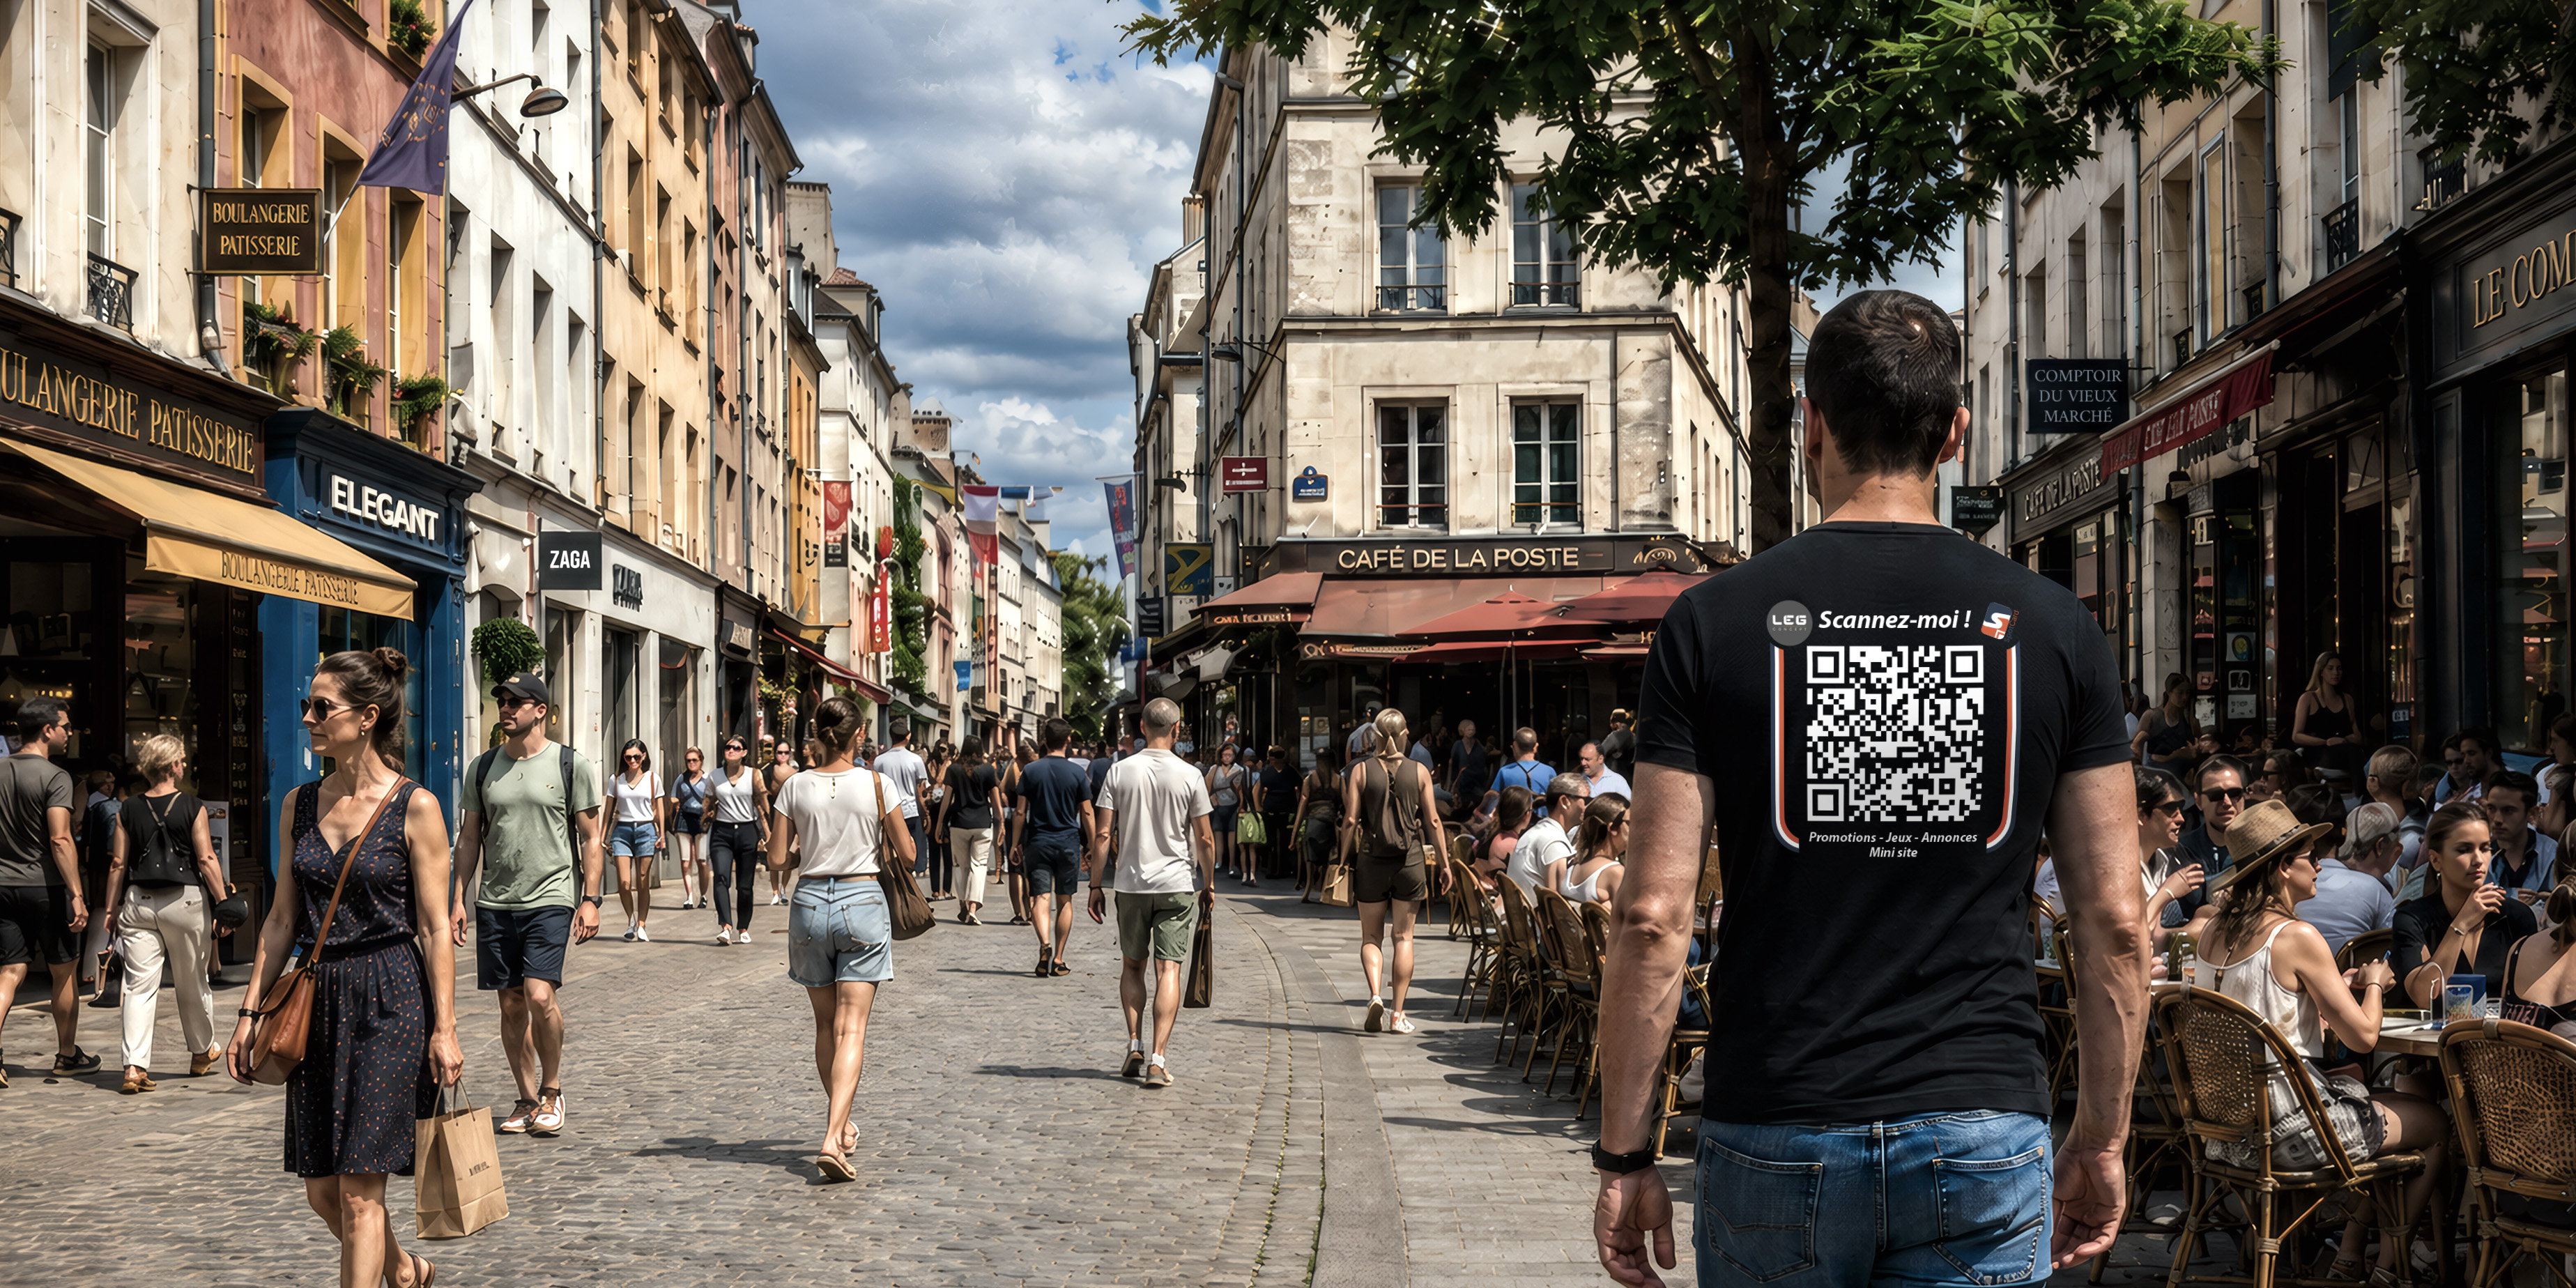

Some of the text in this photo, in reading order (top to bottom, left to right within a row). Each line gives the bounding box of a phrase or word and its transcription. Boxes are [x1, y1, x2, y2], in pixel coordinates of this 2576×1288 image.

[213, 202, 310, 224] BOULANGERIE
[220, 235, 301, 256] PATISSERIE
[2473, 229, 2576, 329] LE COM
[2034, 369, 2122, 382] COMPTOIR
[2039, 390, 2117, 402] DU VIEUX
[2044, 406, 2113, 422] MARCHÉ
[150, 399, 255, 474] PATISSERIE
[332, 475, 438, 541] ELEGANT
[550, 550, 590, 569] ZAGA
[1338, 545, 1579, 569] CAFÉ DE LA POSTE
[1772, 615, 1807, 625] LEG
[1818, 610, 1959, 629] Scannez-moi
[1809, 831, 1876, 843] Promotions
[1885, 831, 1912, 843] Jeux
[1921, 831, 1977, 843] Annonces
[1869, 847, 1917, 857] Mini site
